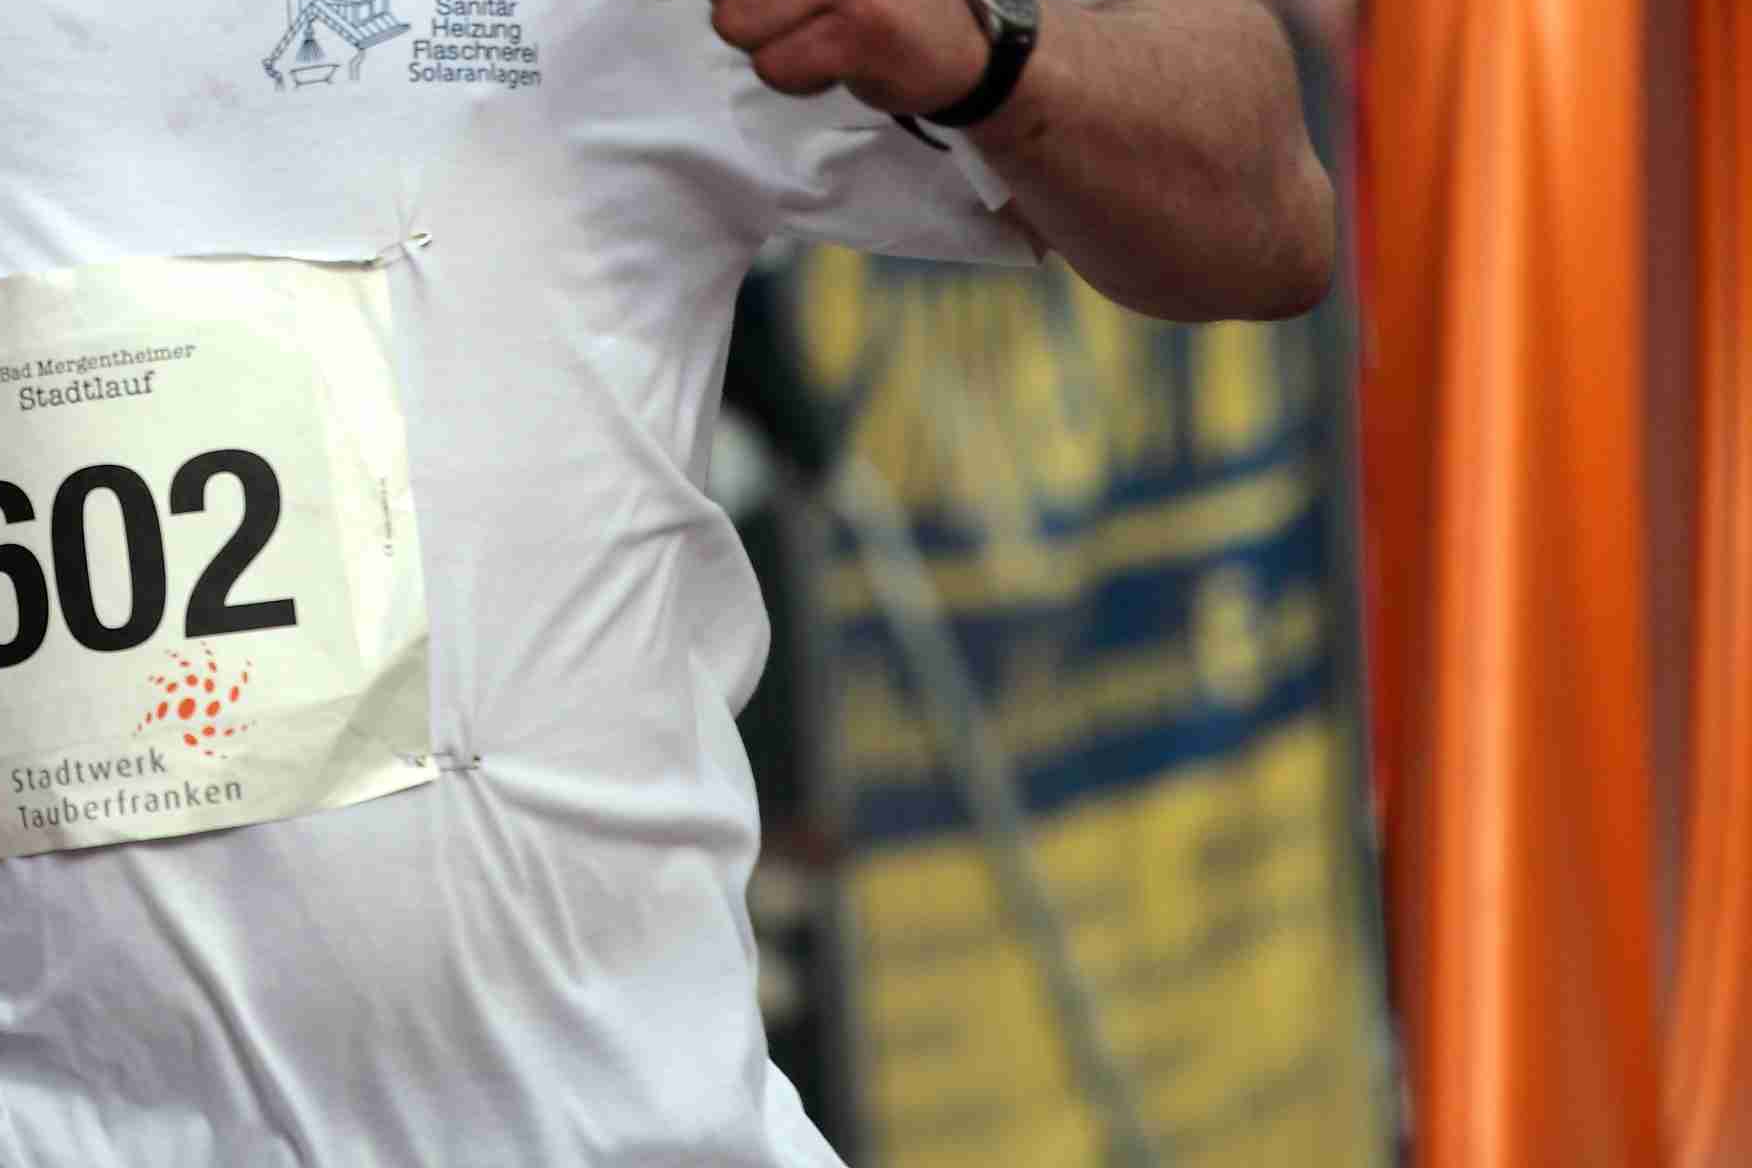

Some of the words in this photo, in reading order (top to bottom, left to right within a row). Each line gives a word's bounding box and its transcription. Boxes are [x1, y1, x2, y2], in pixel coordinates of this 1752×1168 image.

[432, 18, 522, 43] Heizung
[412, 39, 539, 63] Flaschnerei
[408, 62, 543, 88] Solaranlagen
[36, 344, 197, 377] Mergentheimer
[18, 370, 156, 412] Stadtlauf
[11, 746, 168, 794] Stadtwerk
[17, 779, 242, 831] Tauberfranken
